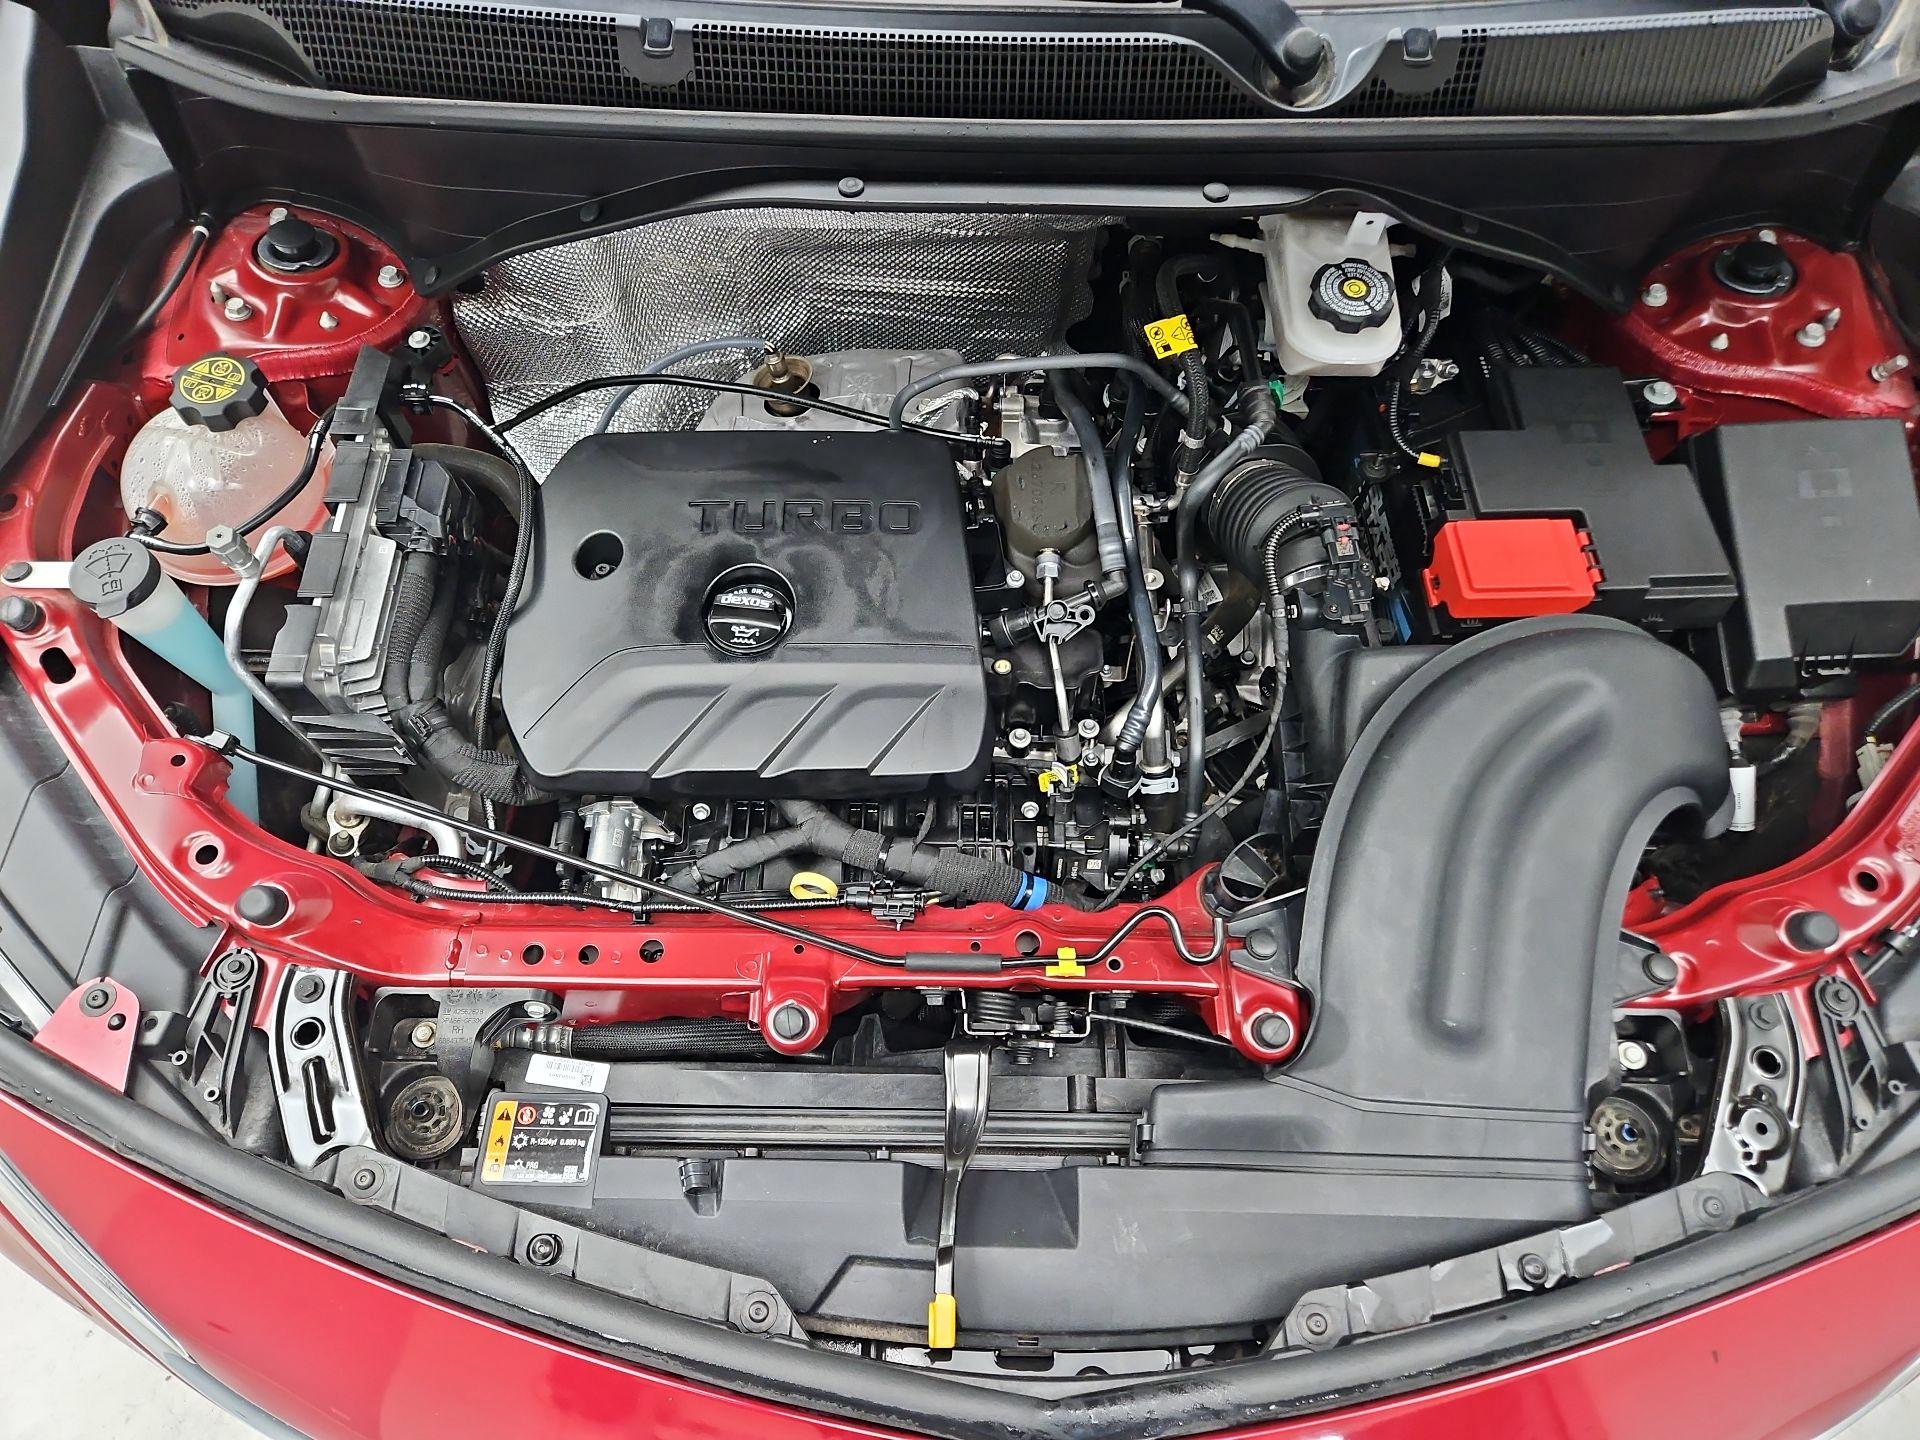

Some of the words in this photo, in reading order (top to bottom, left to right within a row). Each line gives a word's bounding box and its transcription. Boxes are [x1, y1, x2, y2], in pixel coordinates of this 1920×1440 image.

[688, 499, 922, 535] TURBO
[720, 593, 773, 609] dexos
[540, 1117, 555, 1125] AUTO
[530, 1138, 558, 1147] R-1234yf
[577, 1139, 586, 1148] kg
